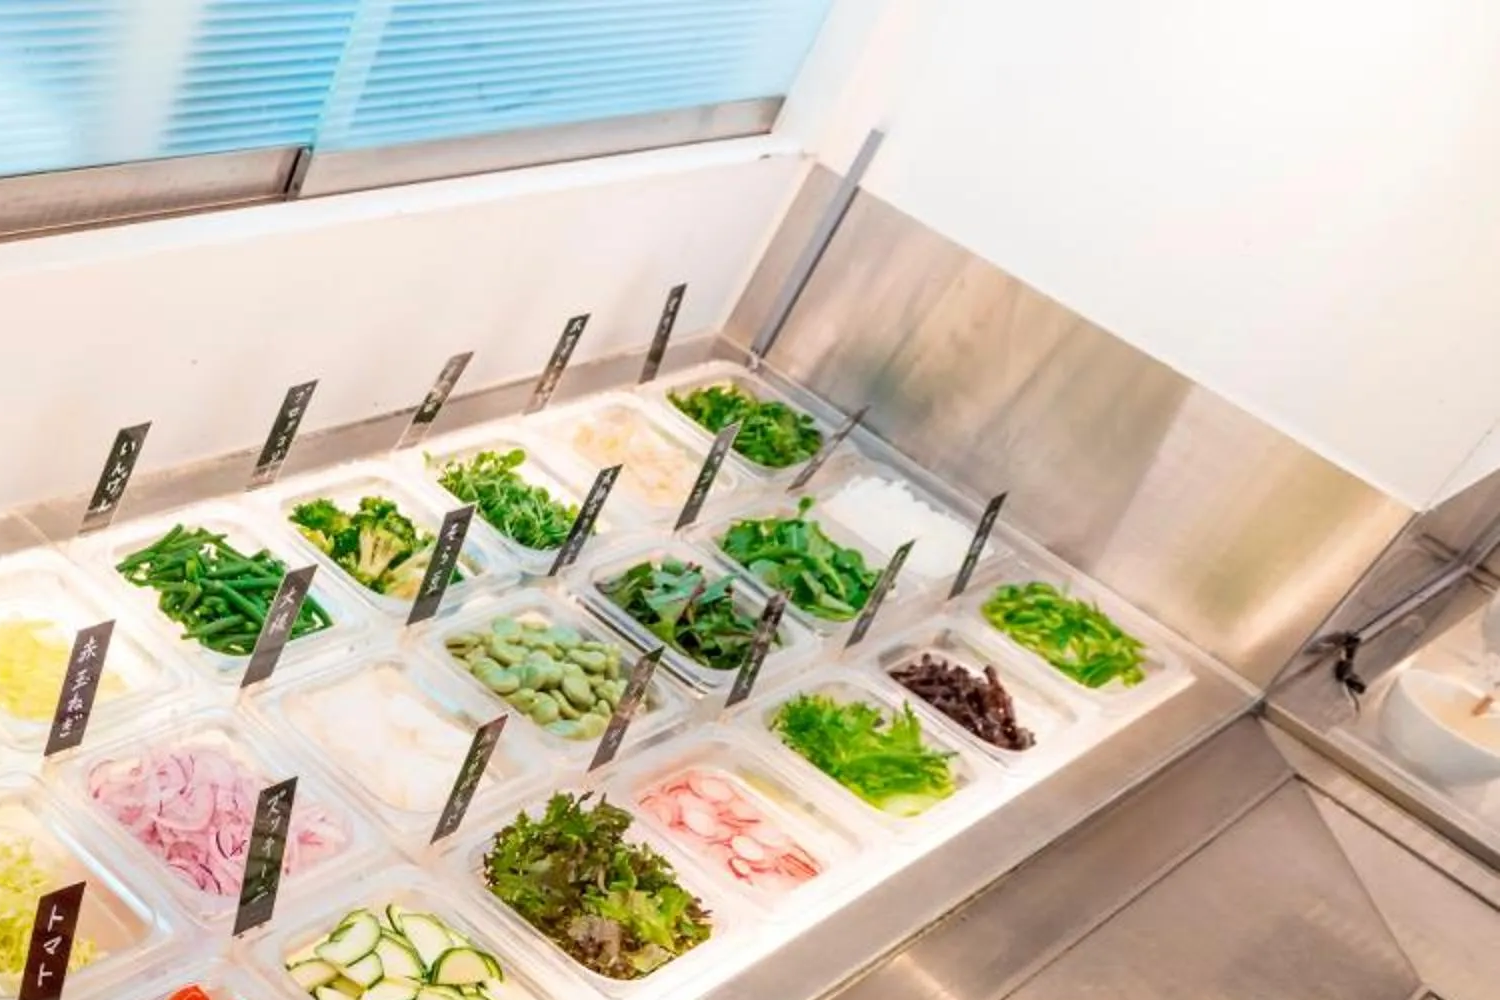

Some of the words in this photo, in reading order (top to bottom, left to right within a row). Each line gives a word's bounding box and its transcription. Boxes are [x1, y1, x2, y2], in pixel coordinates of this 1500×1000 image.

[59, 635, 99, 739] 赤玉ねぎ
[251, 788, 287, 904] ズッキーニ
[37, 903, 65, 988] トマト
